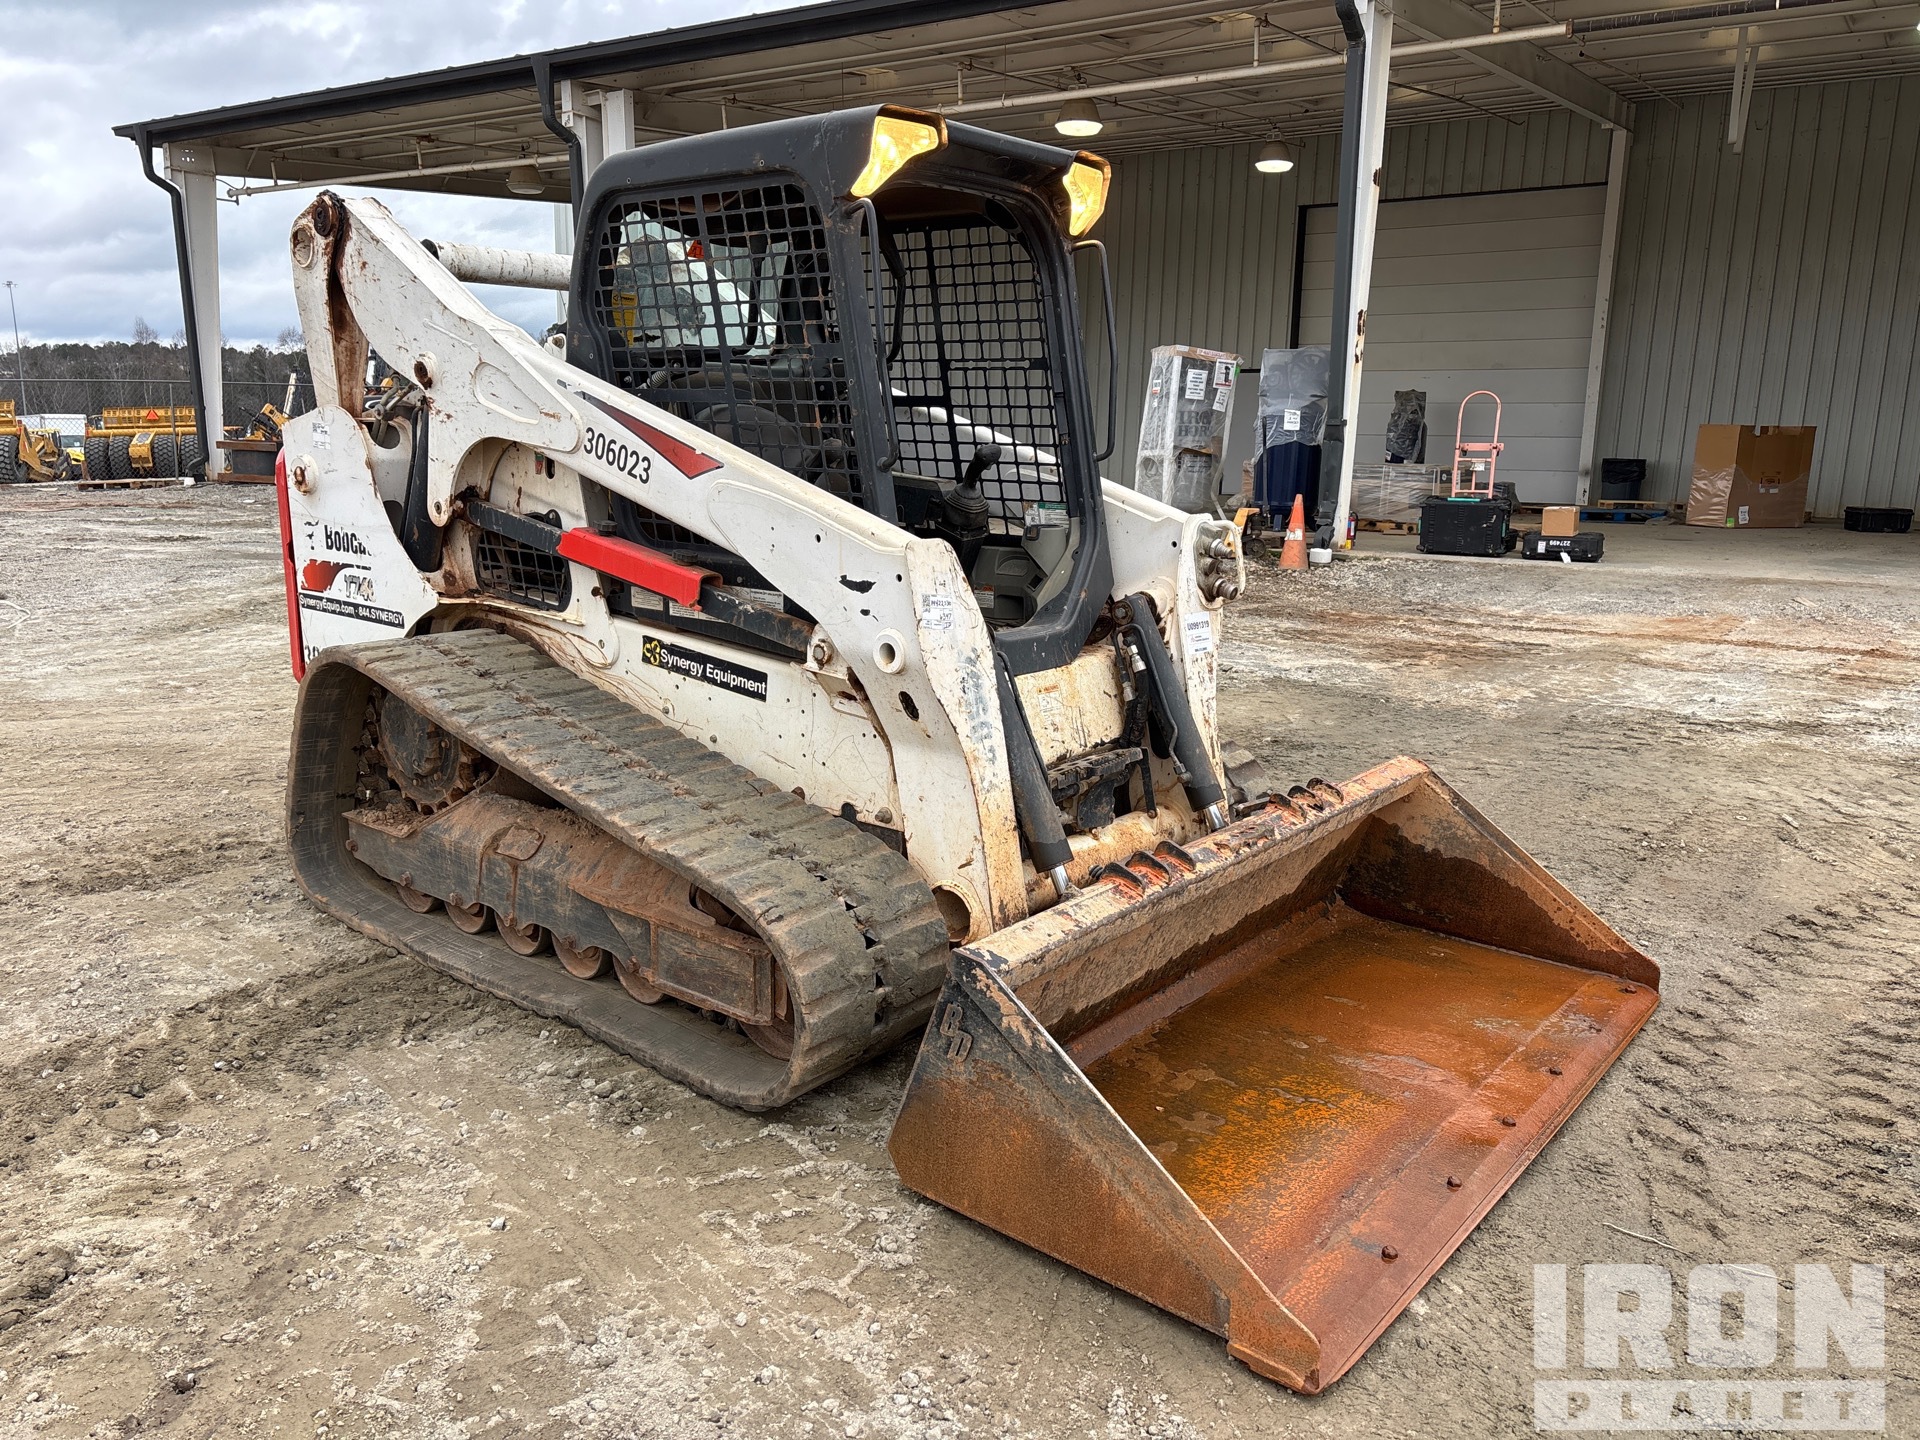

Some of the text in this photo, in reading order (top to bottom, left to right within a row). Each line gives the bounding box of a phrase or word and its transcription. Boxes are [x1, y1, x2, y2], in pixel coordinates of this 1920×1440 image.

[583, 426, 652, 485] 306023
[299, 594, 405, 625] SynergyEquip.com 844.SYNERGY
[660, 648, 767, 695] Synergy Equipment
